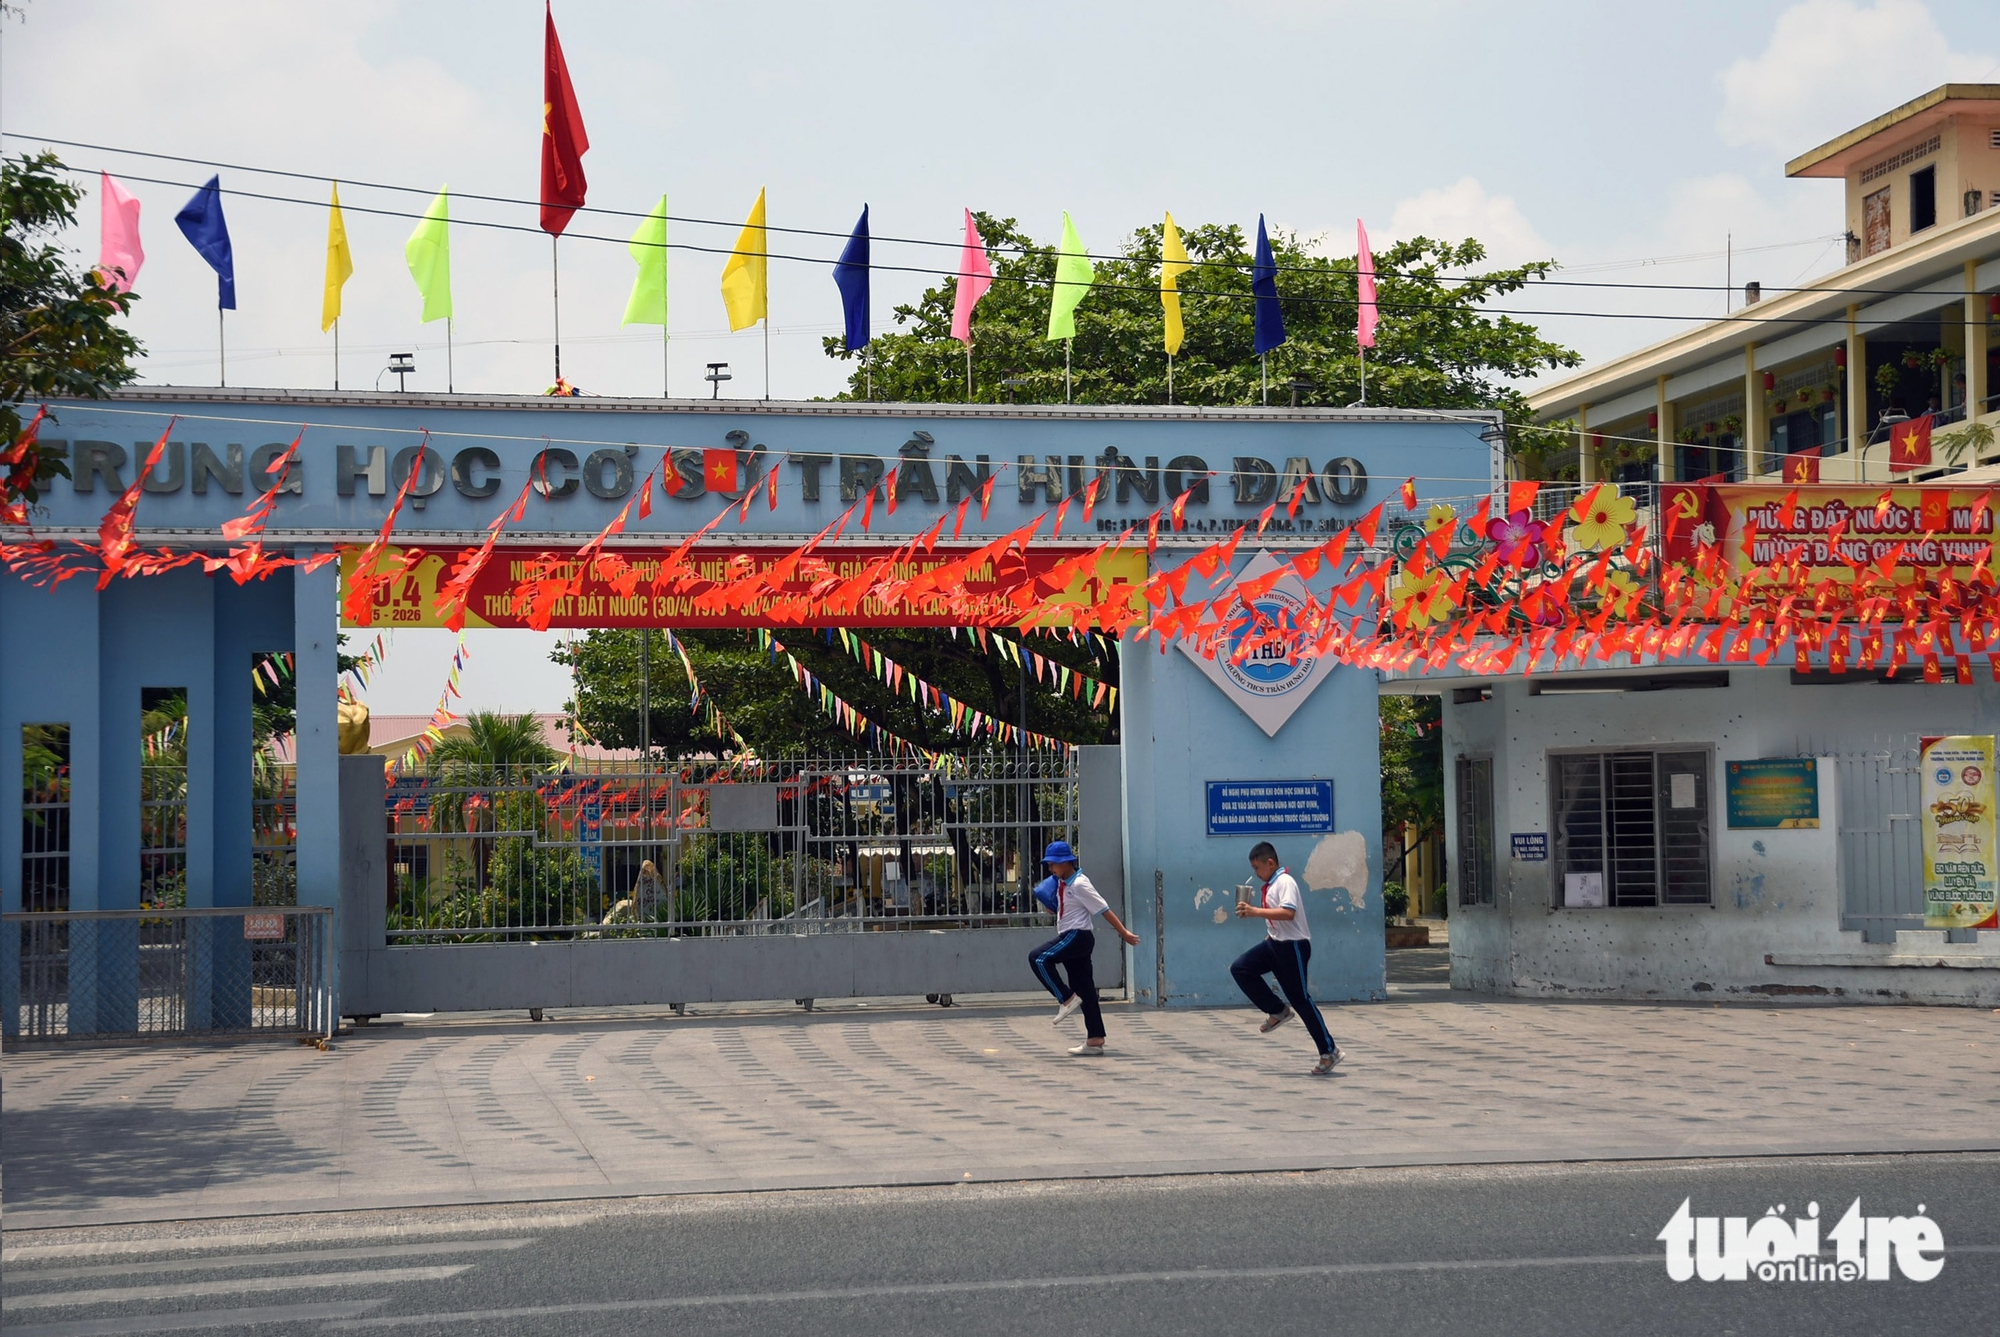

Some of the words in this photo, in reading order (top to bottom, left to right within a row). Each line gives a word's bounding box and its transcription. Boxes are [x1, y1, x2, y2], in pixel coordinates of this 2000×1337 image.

[336, 445, 501, 509] HỌC
[530, 442, 640, 498] CƠ
[787, 431, 990, 502] TRẦN
[1018, 445, 1210, 503] HƯNG
[1230, 457, 1368, 515] ĐẠO
[1750, 502, 1805, 529] MỪG
[1811, 500, 1849, 529] ĐẤT
[360, 574, 422, 607] 0.4
[578, 588, 605, 616] ĐẤT
[392, 609, 422, 621] 2026
[1246, 682, 1265, 693] THCS
[1513, 836, 1525, 845] VUI
[1526, 835, 1544, 845] LÒNG
